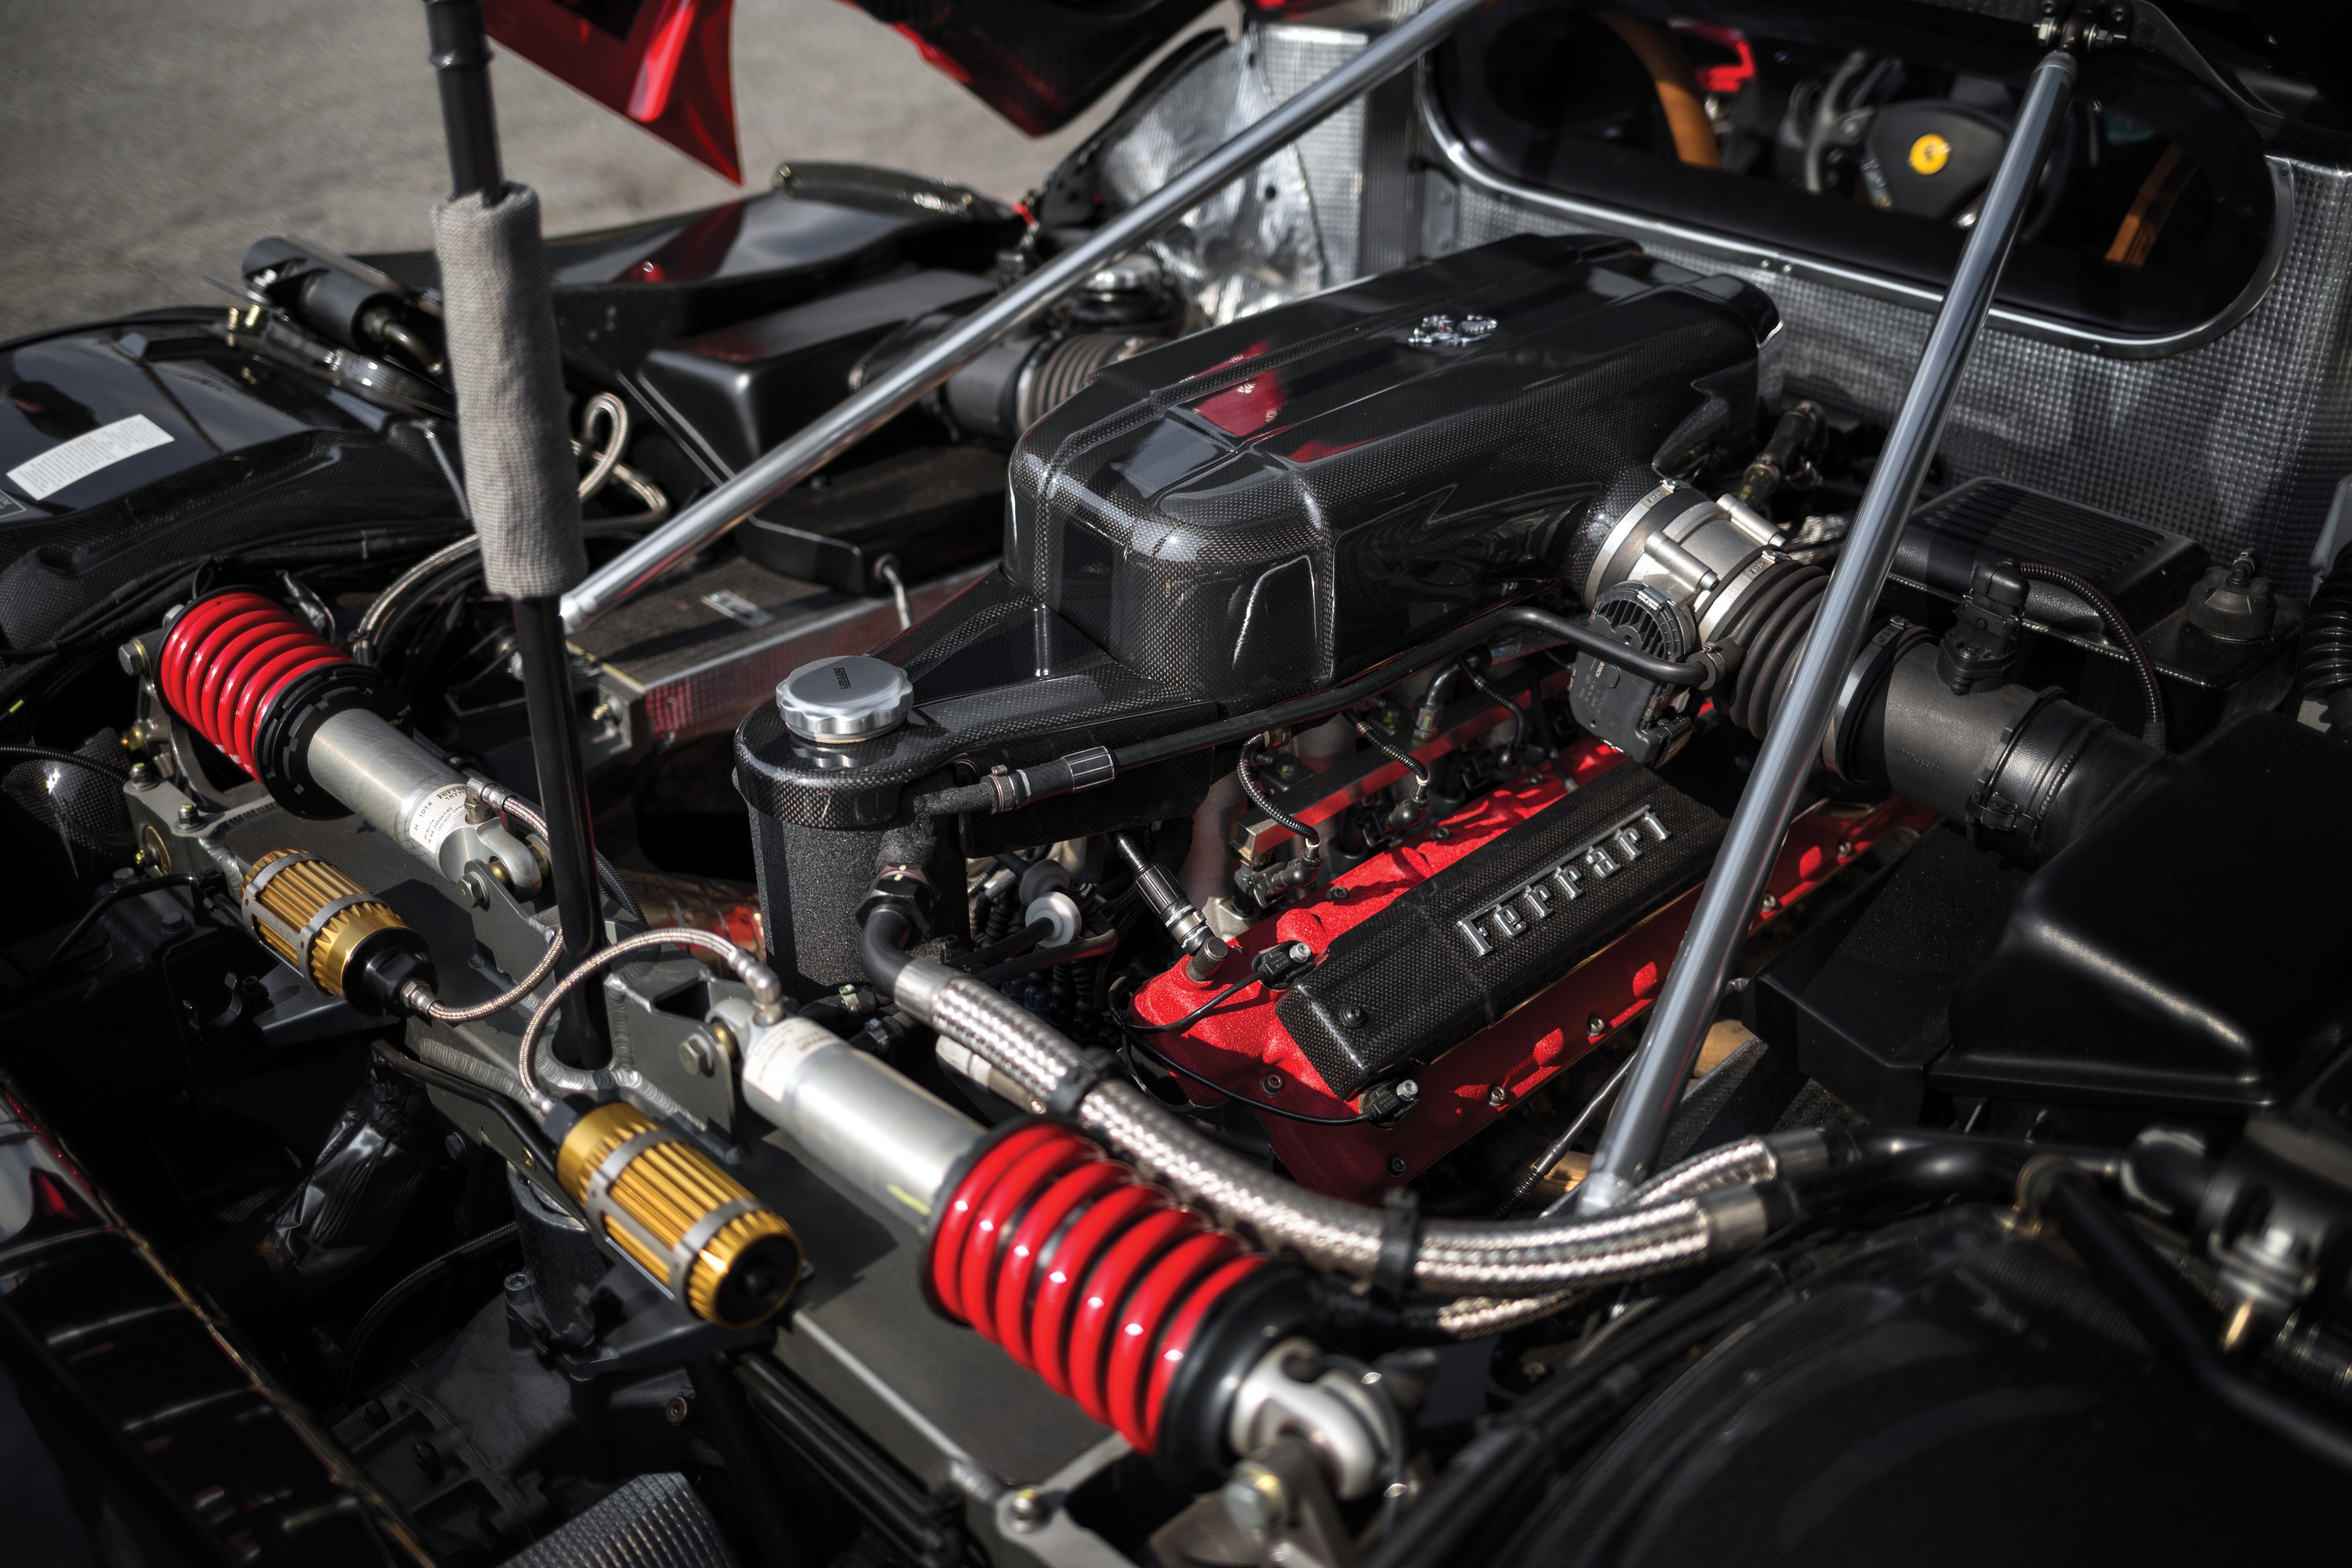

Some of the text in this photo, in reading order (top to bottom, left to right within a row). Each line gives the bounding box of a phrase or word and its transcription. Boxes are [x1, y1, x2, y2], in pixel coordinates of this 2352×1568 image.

[1595, 661, 1605, 678] BOSCH
[833, 667, 852, 690] Ferrari
[436, 785, 466, 800] Ferrar
[419, 801, 433, 817] 1014
[443, 813, 452, 823] NOT
[430, 830, 435, 838] 44
[1456, 804, 1672, 957] Ferrari
